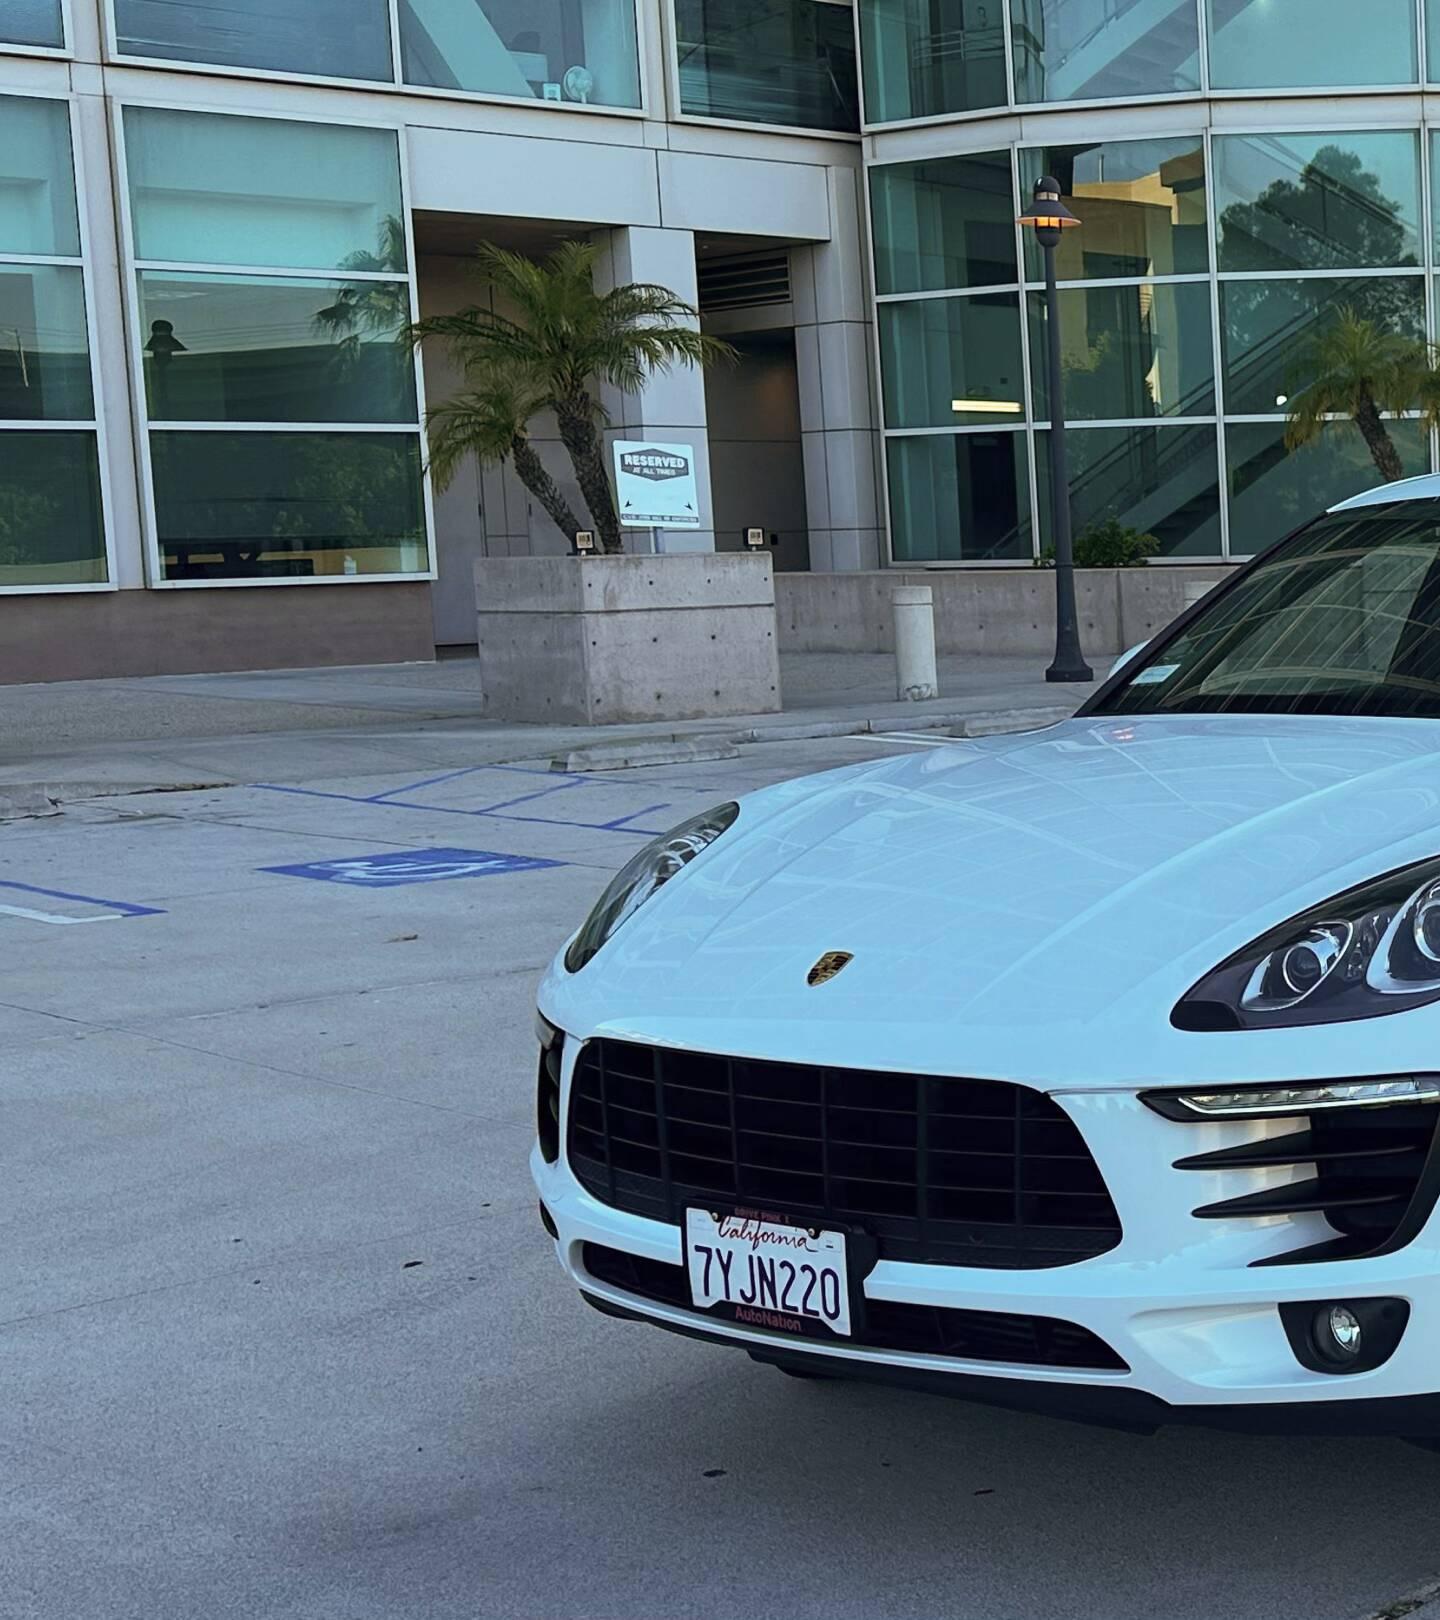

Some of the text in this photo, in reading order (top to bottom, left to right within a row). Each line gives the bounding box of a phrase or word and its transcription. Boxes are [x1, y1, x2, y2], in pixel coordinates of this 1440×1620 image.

[624, 454, 685, 468] RESERVED
[642, 467, 655, 475] ALL
[718, 1216, 818, 1251] California
[694, 1244, 840, 1320] 7YJN220
[735, 1305, 801, 1331] AutoNation
